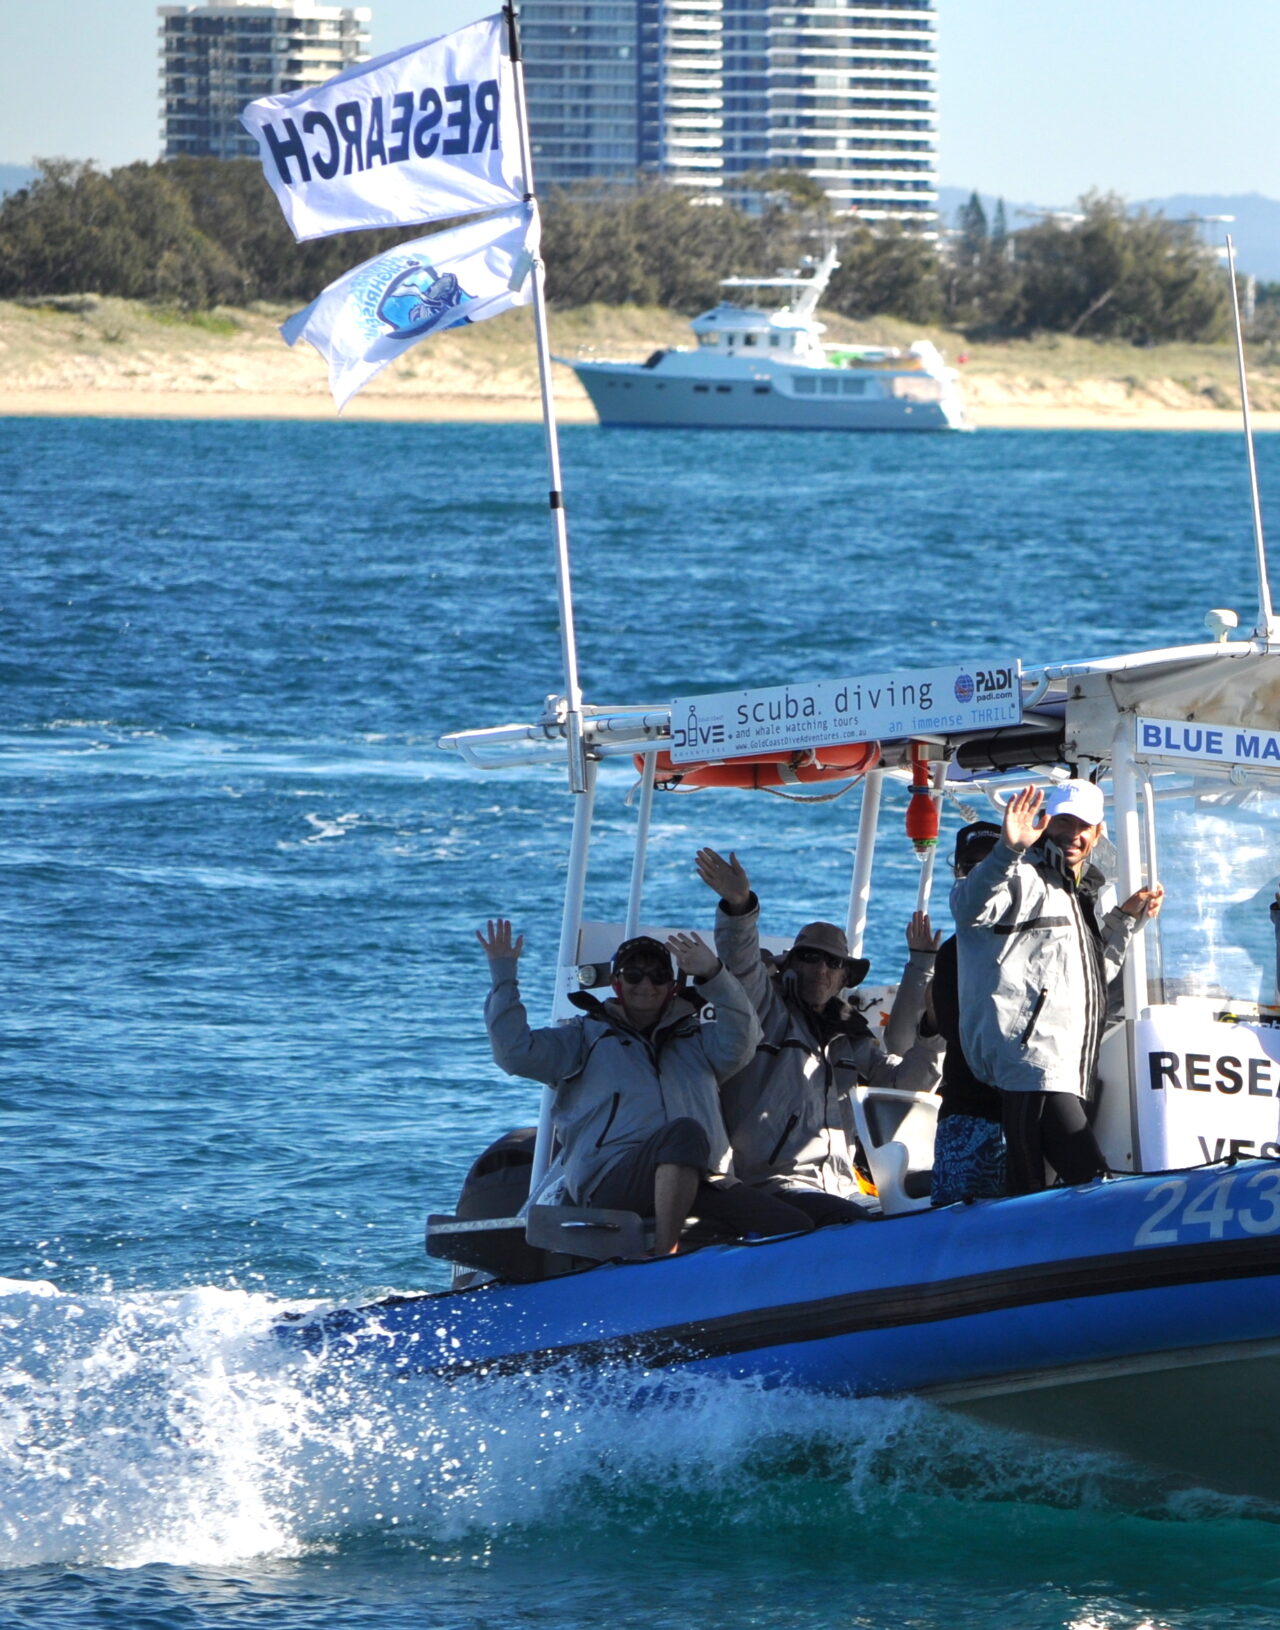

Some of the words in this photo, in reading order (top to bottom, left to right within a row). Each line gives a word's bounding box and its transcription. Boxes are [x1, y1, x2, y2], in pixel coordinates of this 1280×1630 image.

[976, 668, 1013, 692] PADI
[834, 681, 934, 711] diving
[976, 691, 1013, 704] padi.com
[735, 725, 750, 740] and
[755, 722, 781, 736] whale
[785, 717, 828, 733] watching
[833, 715, 859, 728] tours
[889, 721, 903, 733] an
[912, 714, 963, 730] immense
[971, 706, 1015, 724] THRILL
[1142, 724, 1223, 756] BLUE
